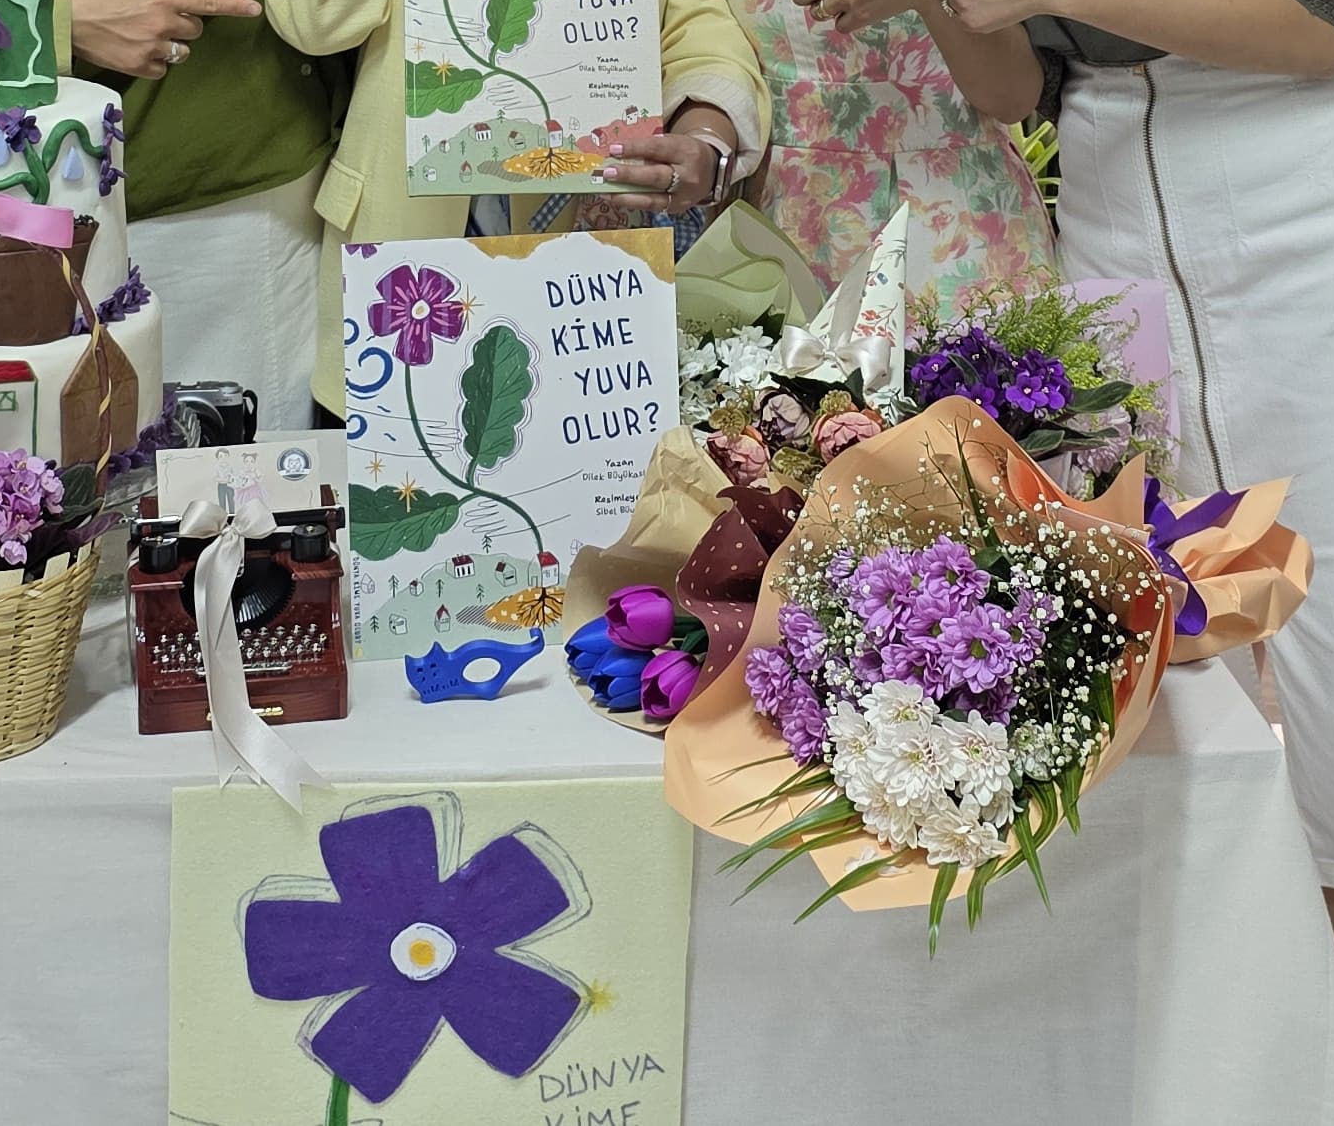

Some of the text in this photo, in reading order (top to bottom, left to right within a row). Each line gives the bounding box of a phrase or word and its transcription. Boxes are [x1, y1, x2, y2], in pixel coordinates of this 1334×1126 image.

[563, 15, 639, 45] OLUR?
[545, 268, 644, 309] DÜNYA
[551, 316, 635, 357] KİME
[574, 358, 654, 397] YUVA
[562, 400, 661, 446] OLUR?
[582, 468, 646, 483] Dilek Büyükasl
[605, 458, 634, 468] Yazan
[595, 506, 618, 516] Sibel
[538, 1052, 666, 1104] DÜNYA
